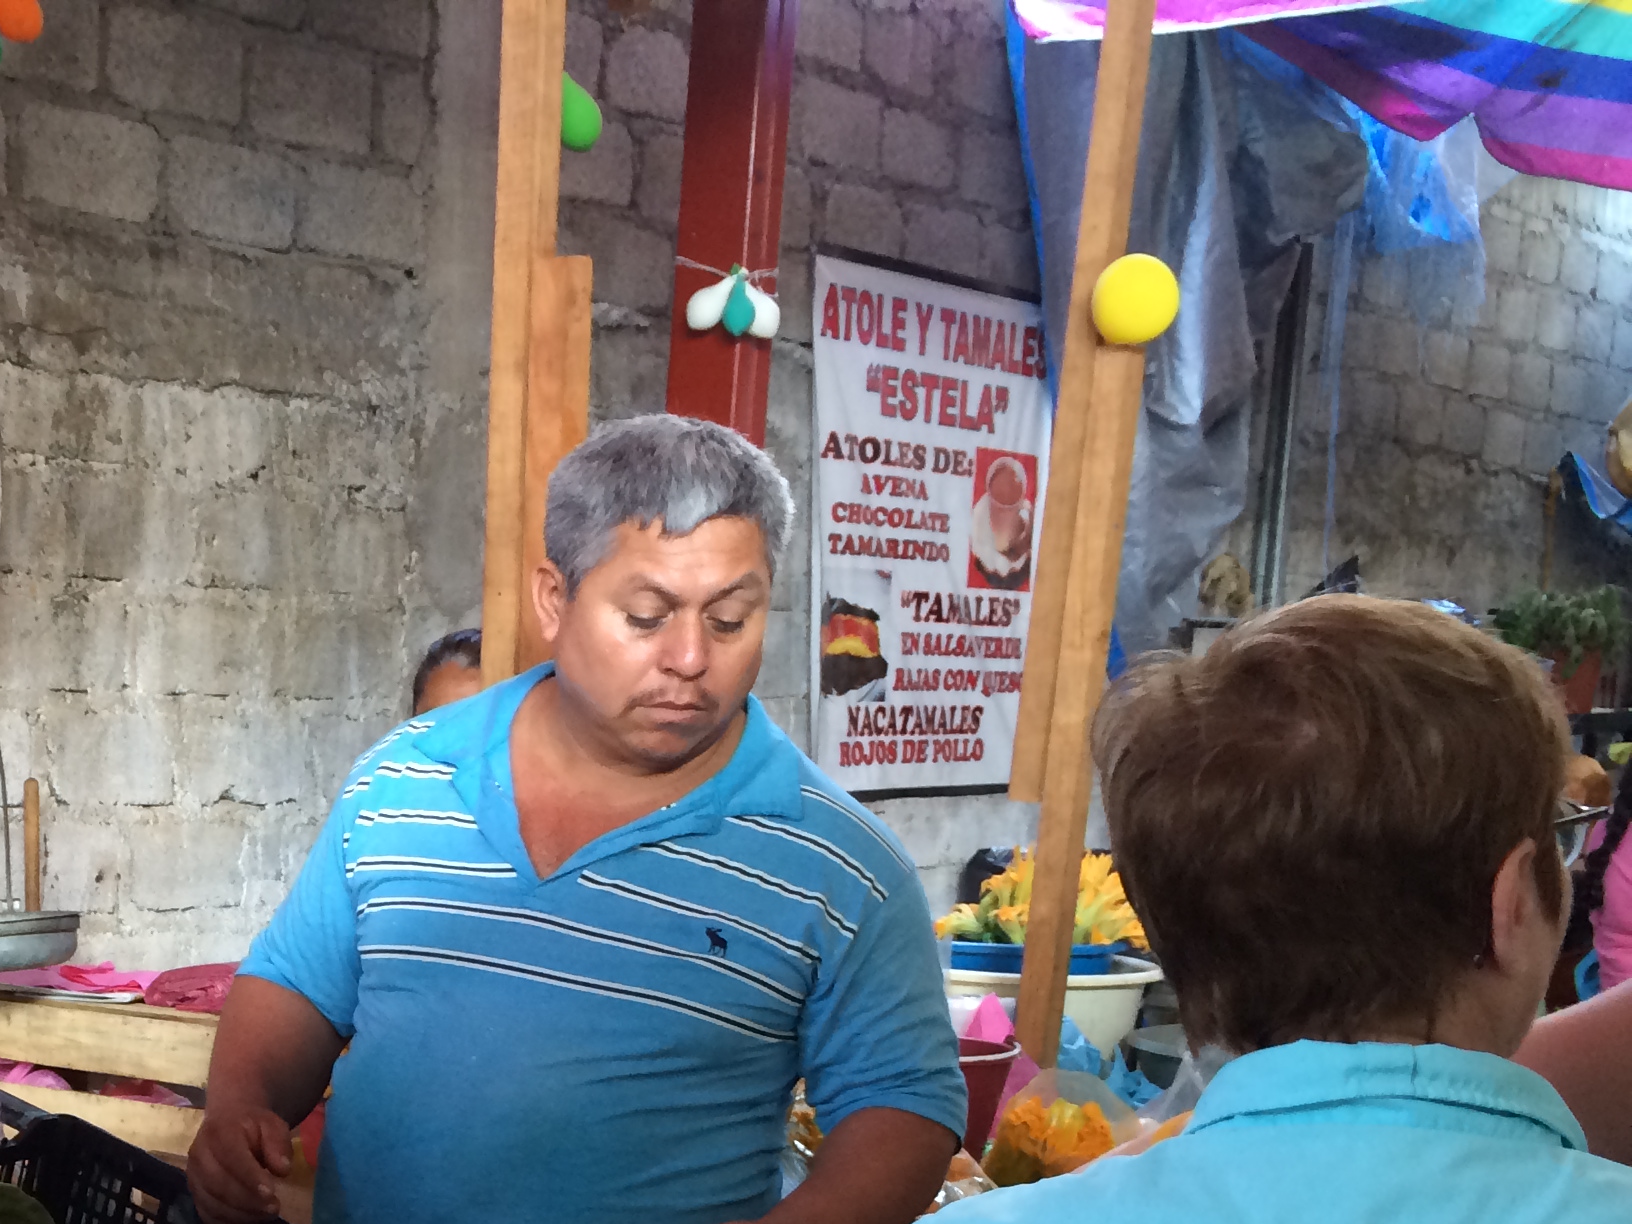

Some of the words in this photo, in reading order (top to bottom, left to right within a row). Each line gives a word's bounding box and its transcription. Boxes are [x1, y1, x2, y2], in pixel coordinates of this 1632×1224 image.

[821, 283, 908, 351] ATOLE
[915, 302, 934, 356] Y
[821, 431, 927, 471] ATOLES
[932, 446, 974, 478] DE:
[860, 473, 929, 501] AVENA
[831, 501, 950, 533] CHOCOLATE
[828, 533, 950, 562] TAMARINDO
[900, 631, 921, 656] EN
[922, 632, 975, 658] SALSA
[892, 667, 941, 692] RAJAS
[943, 668, 981, 692] CON
[846, 705, 984, 738] NACATAMALES
[838, 741, 898, 767] ROJOS
[901, 741, 928, 764] DE
[933, 738, 984, 763] POLLO
